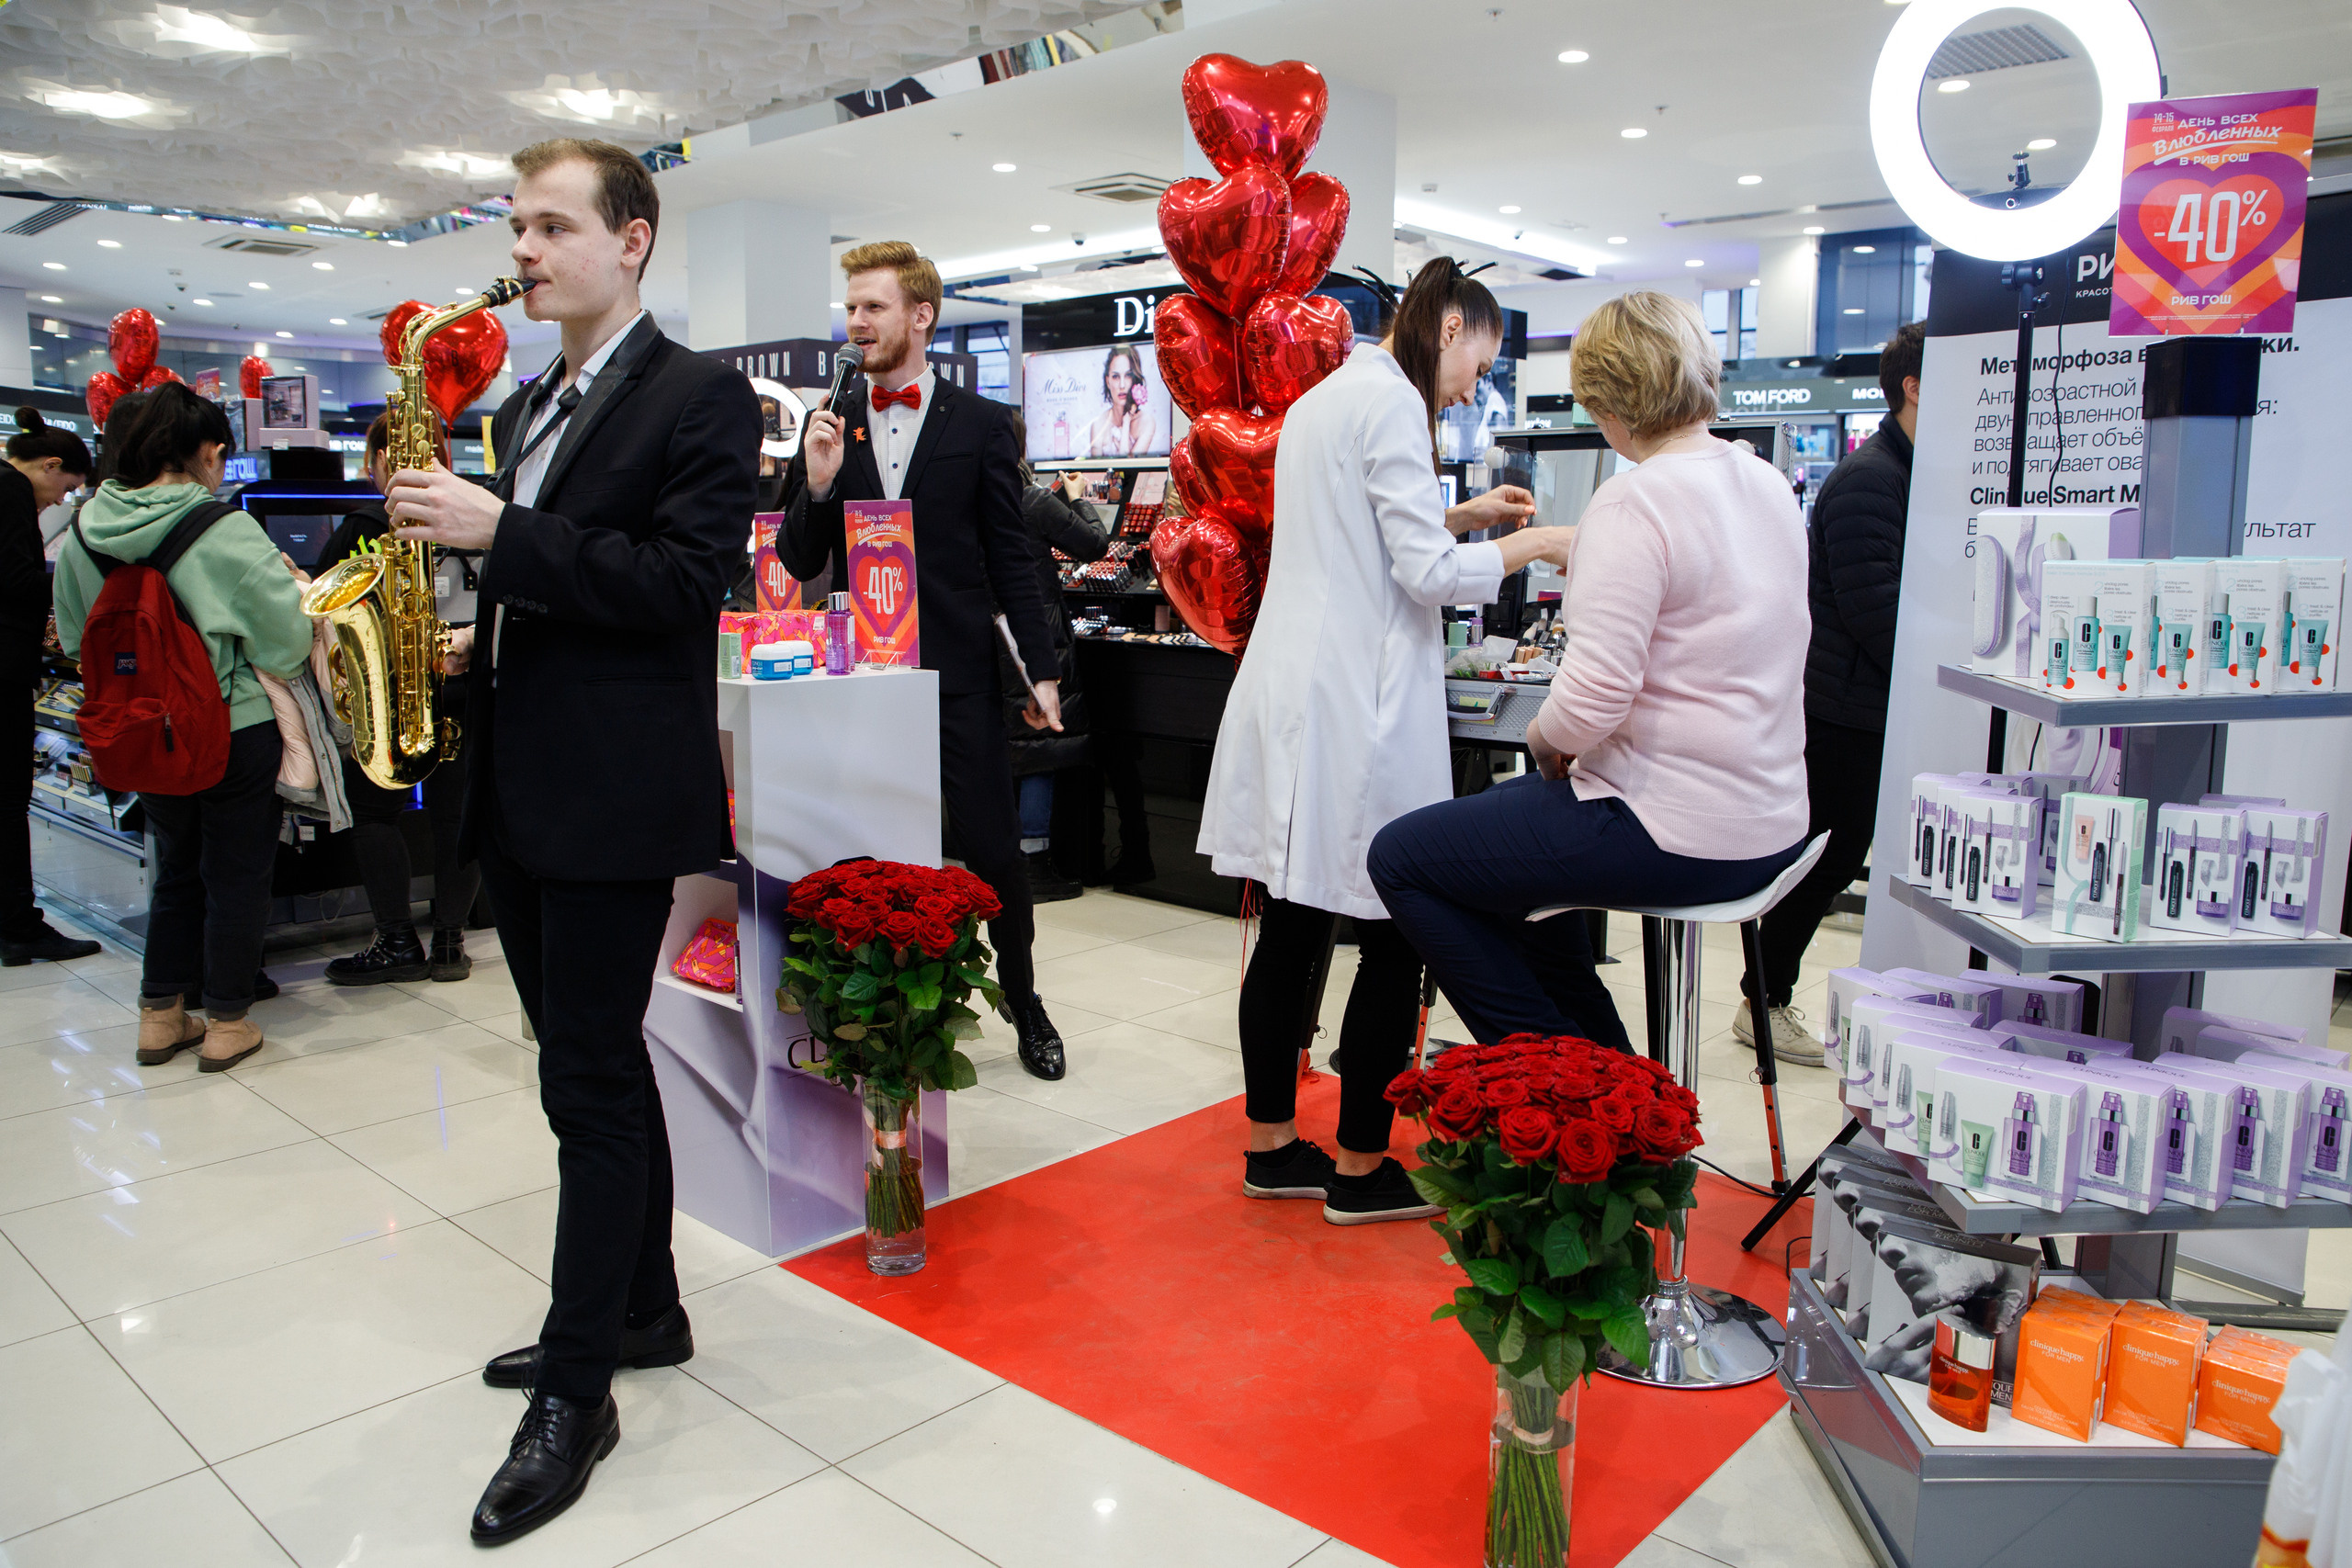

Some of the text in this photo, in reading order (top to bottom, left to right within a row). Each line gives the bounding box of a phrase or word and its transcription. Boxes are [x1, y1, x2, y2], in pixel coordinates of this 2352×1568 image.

[2154, 112, 2174, 124] 14-15
[2177, 113, 2258, 130] ДЕНЬ ВСЕХ
[2153, 126, 2283, 155] Влюбленных
[2179, 152, 2249, 165] В РИВ ГОШ
[2154, 189, 2268, 263] -40%
[2077, 252, 2115, 282] РИ
[2171, 294, 2232, 305] РИВ ГОШ
[1114, 294, 1155, 337] Di
[737, 351, 790, 378] BROWN
[1981, 349, 2132, 376] Метморфоза
[1733, 388, 1812, 405] TOM FORD
[1975, 406, 2143, 432] двунправленног
[1974, 425, 2143, 453] возващает объё
[1973, 461, 1983, 475] и
[2108, 456, 2143, 470] ова
[1970, 484, 2141, 505] Cliniue Smart M
[856, 522, 901, 540] Влюбленных
[2245, 523, 2316, 538] льтат
[864, 567, 903, 615] -40%
[1941, 1041, 1984, 1054] CLINIQUE
[1986, 1067, 2034, 1081] CLINIQUE
[2073, 1066, 2122, 1080] CLINIQUE
[2138, 1064, 2186, 1078] CLINIQUE
[2030, 1338, 2085, 1362] clinique happy.
[2041, 1349, 2072, 1364] FOR MEN
[2122, 1344, 2180, 1366] clinique happy.
[2134, 1354, 2165, 1368] FOR MEN
[1991, 1390, 2013, 1402] MEN
[2211, 1380, 2271, 1404] clinique happy.
[2223, 1391, 2256, 1404] FOR MEN
